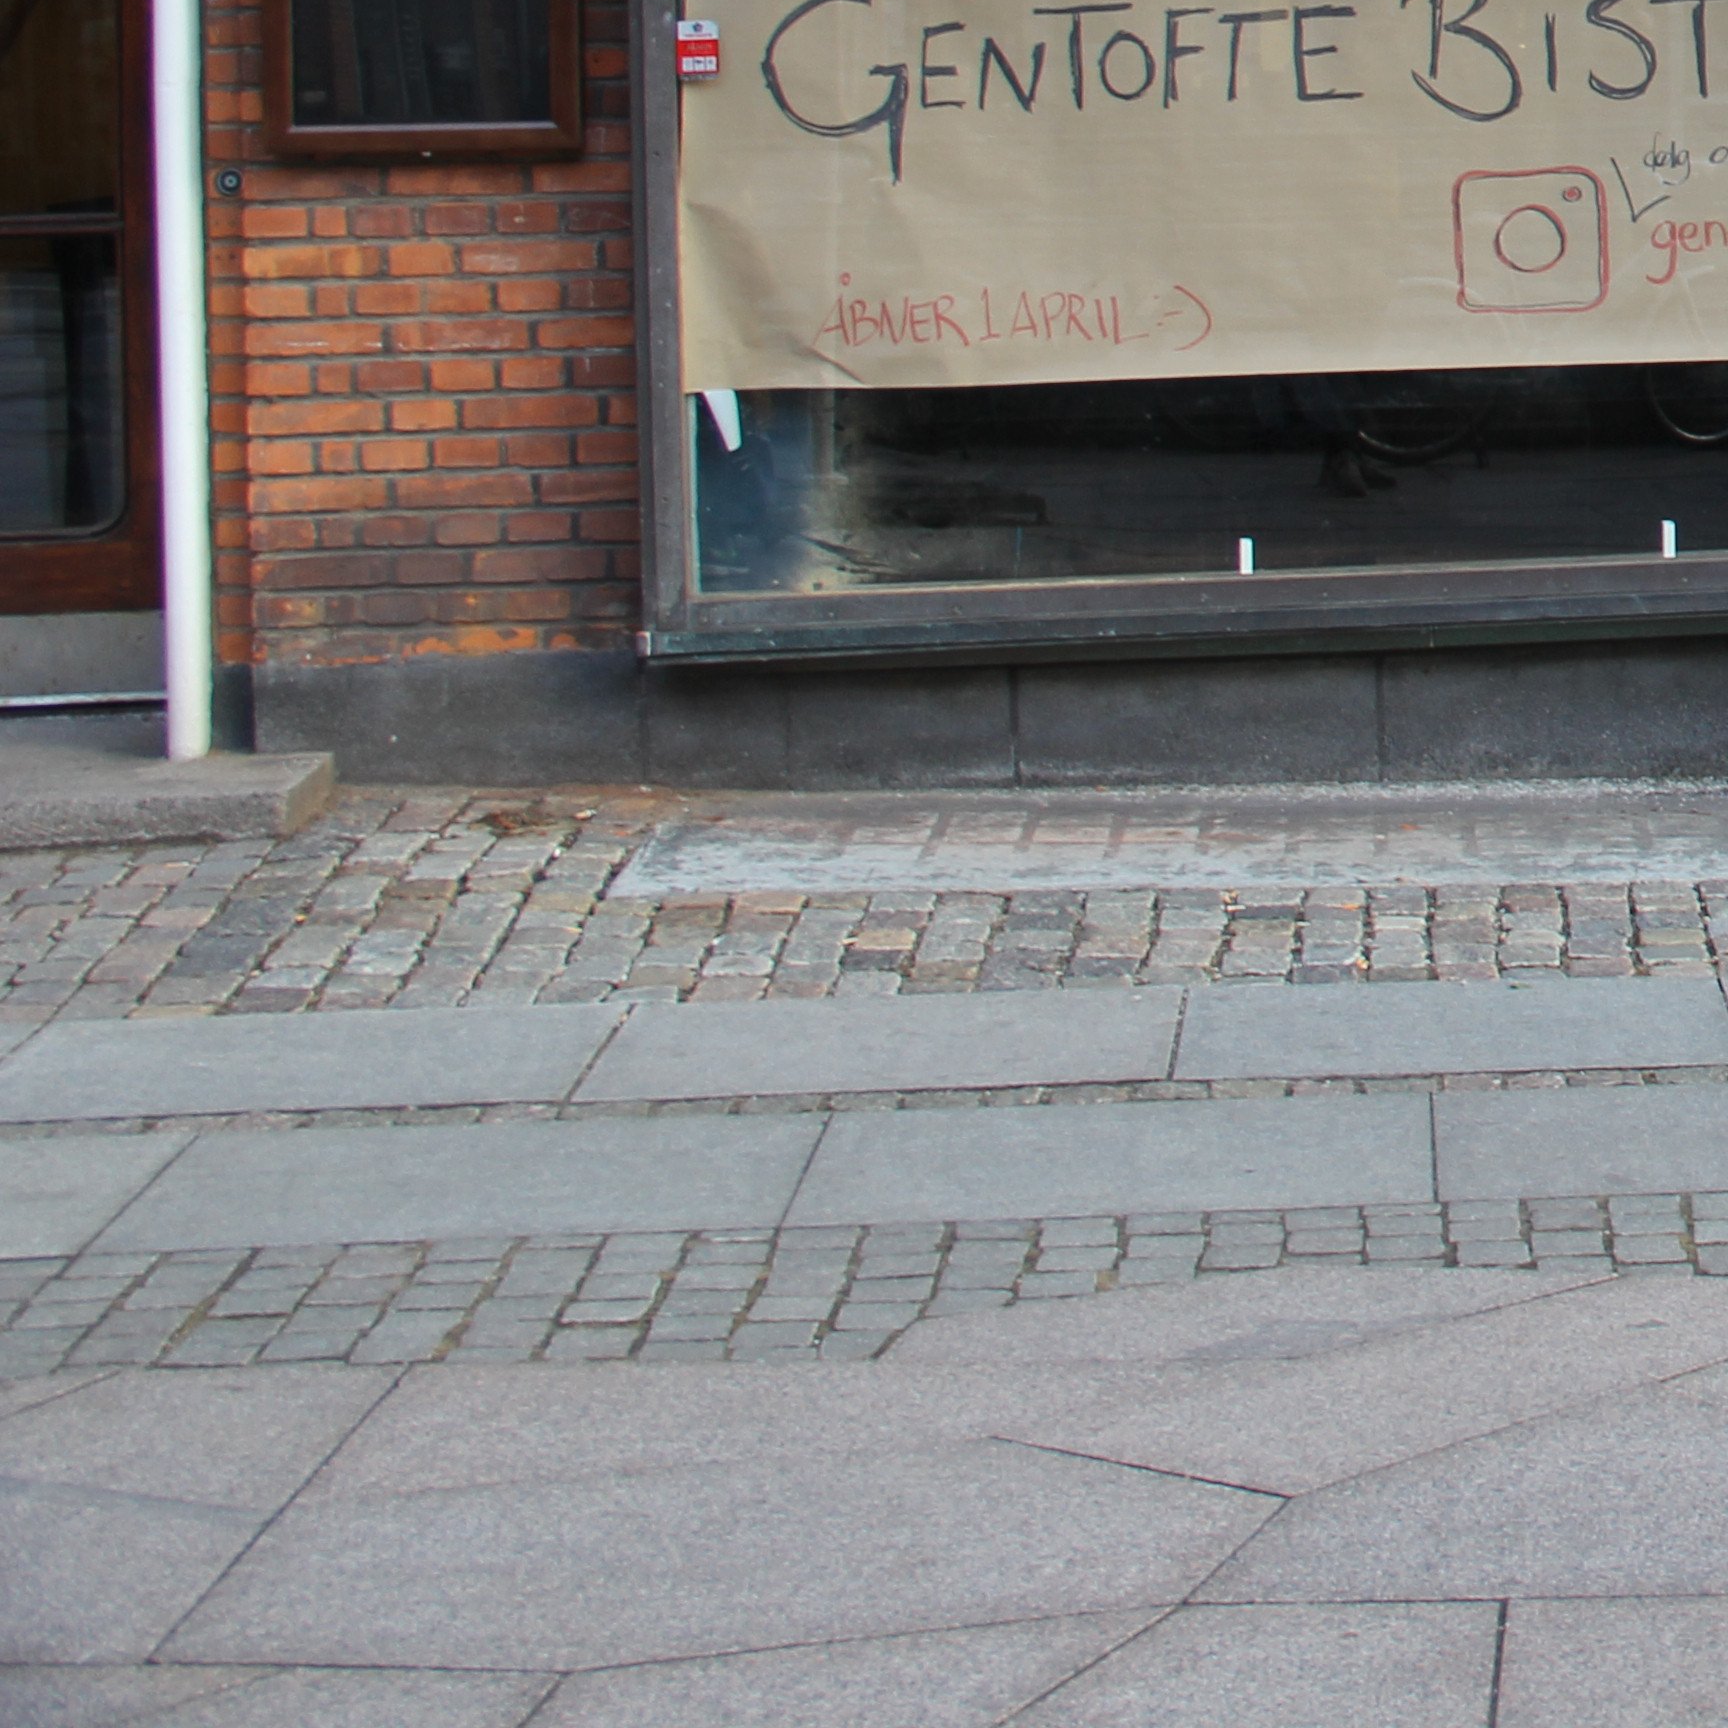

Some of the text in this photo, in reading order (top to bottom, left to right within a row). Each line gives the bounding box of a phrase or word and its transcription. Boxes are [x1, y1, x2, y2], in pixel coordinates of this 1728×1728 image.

[811, 271, 971, 347] ÅBNER
[979, 286, 1001, 343] 1
[1009, 290, 1150, 346] APRIL
